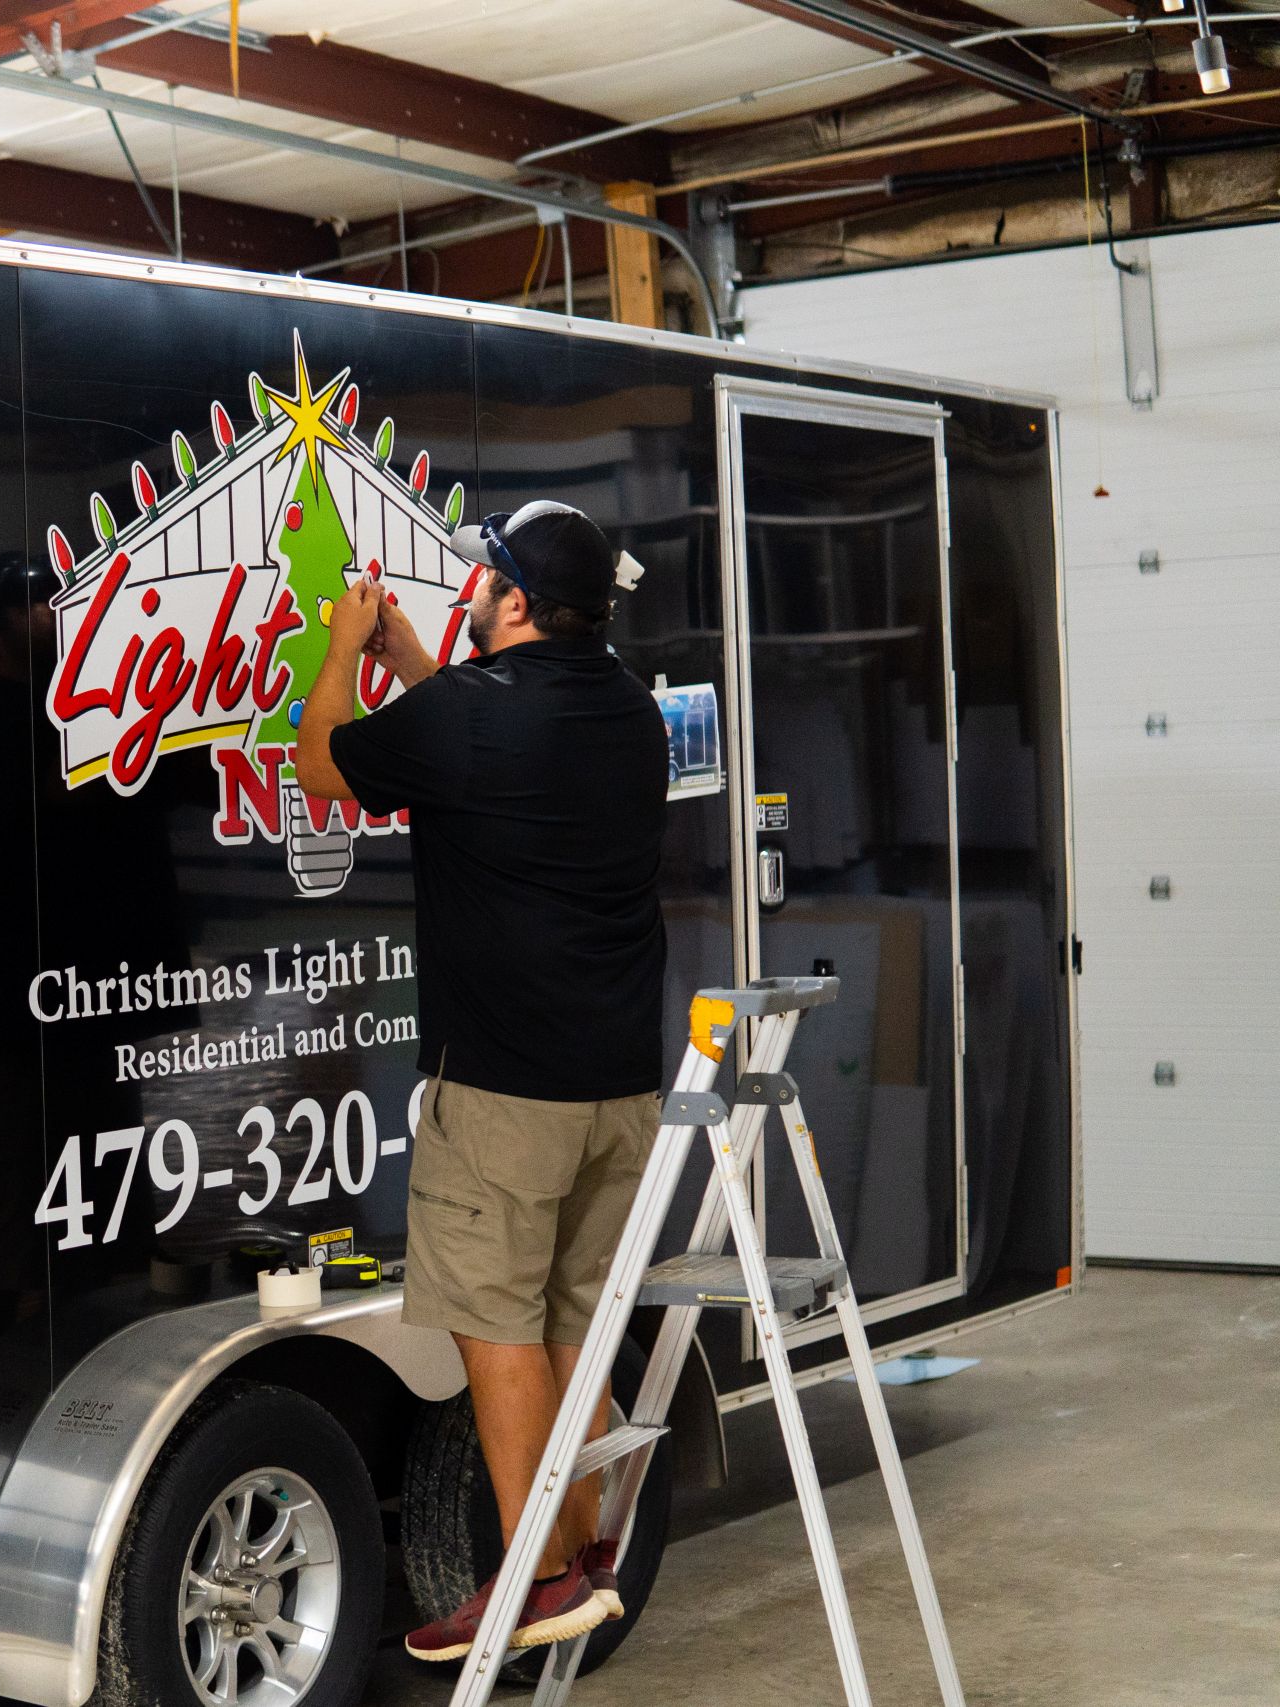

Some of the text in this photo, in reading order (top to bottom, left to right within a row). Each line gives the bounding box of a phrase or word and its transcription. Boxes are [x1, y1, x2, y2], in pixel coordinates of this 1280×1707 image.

[53, 552, 303, 787] Light
[28, 961, 252, 1023] Christmas
[264, 939, 365, 1004] Light
[114, 1022, 286, 1082] Residential
[294, 1014, 347, 1056] and
[323, 1231, 346, 1242] CAUTION
